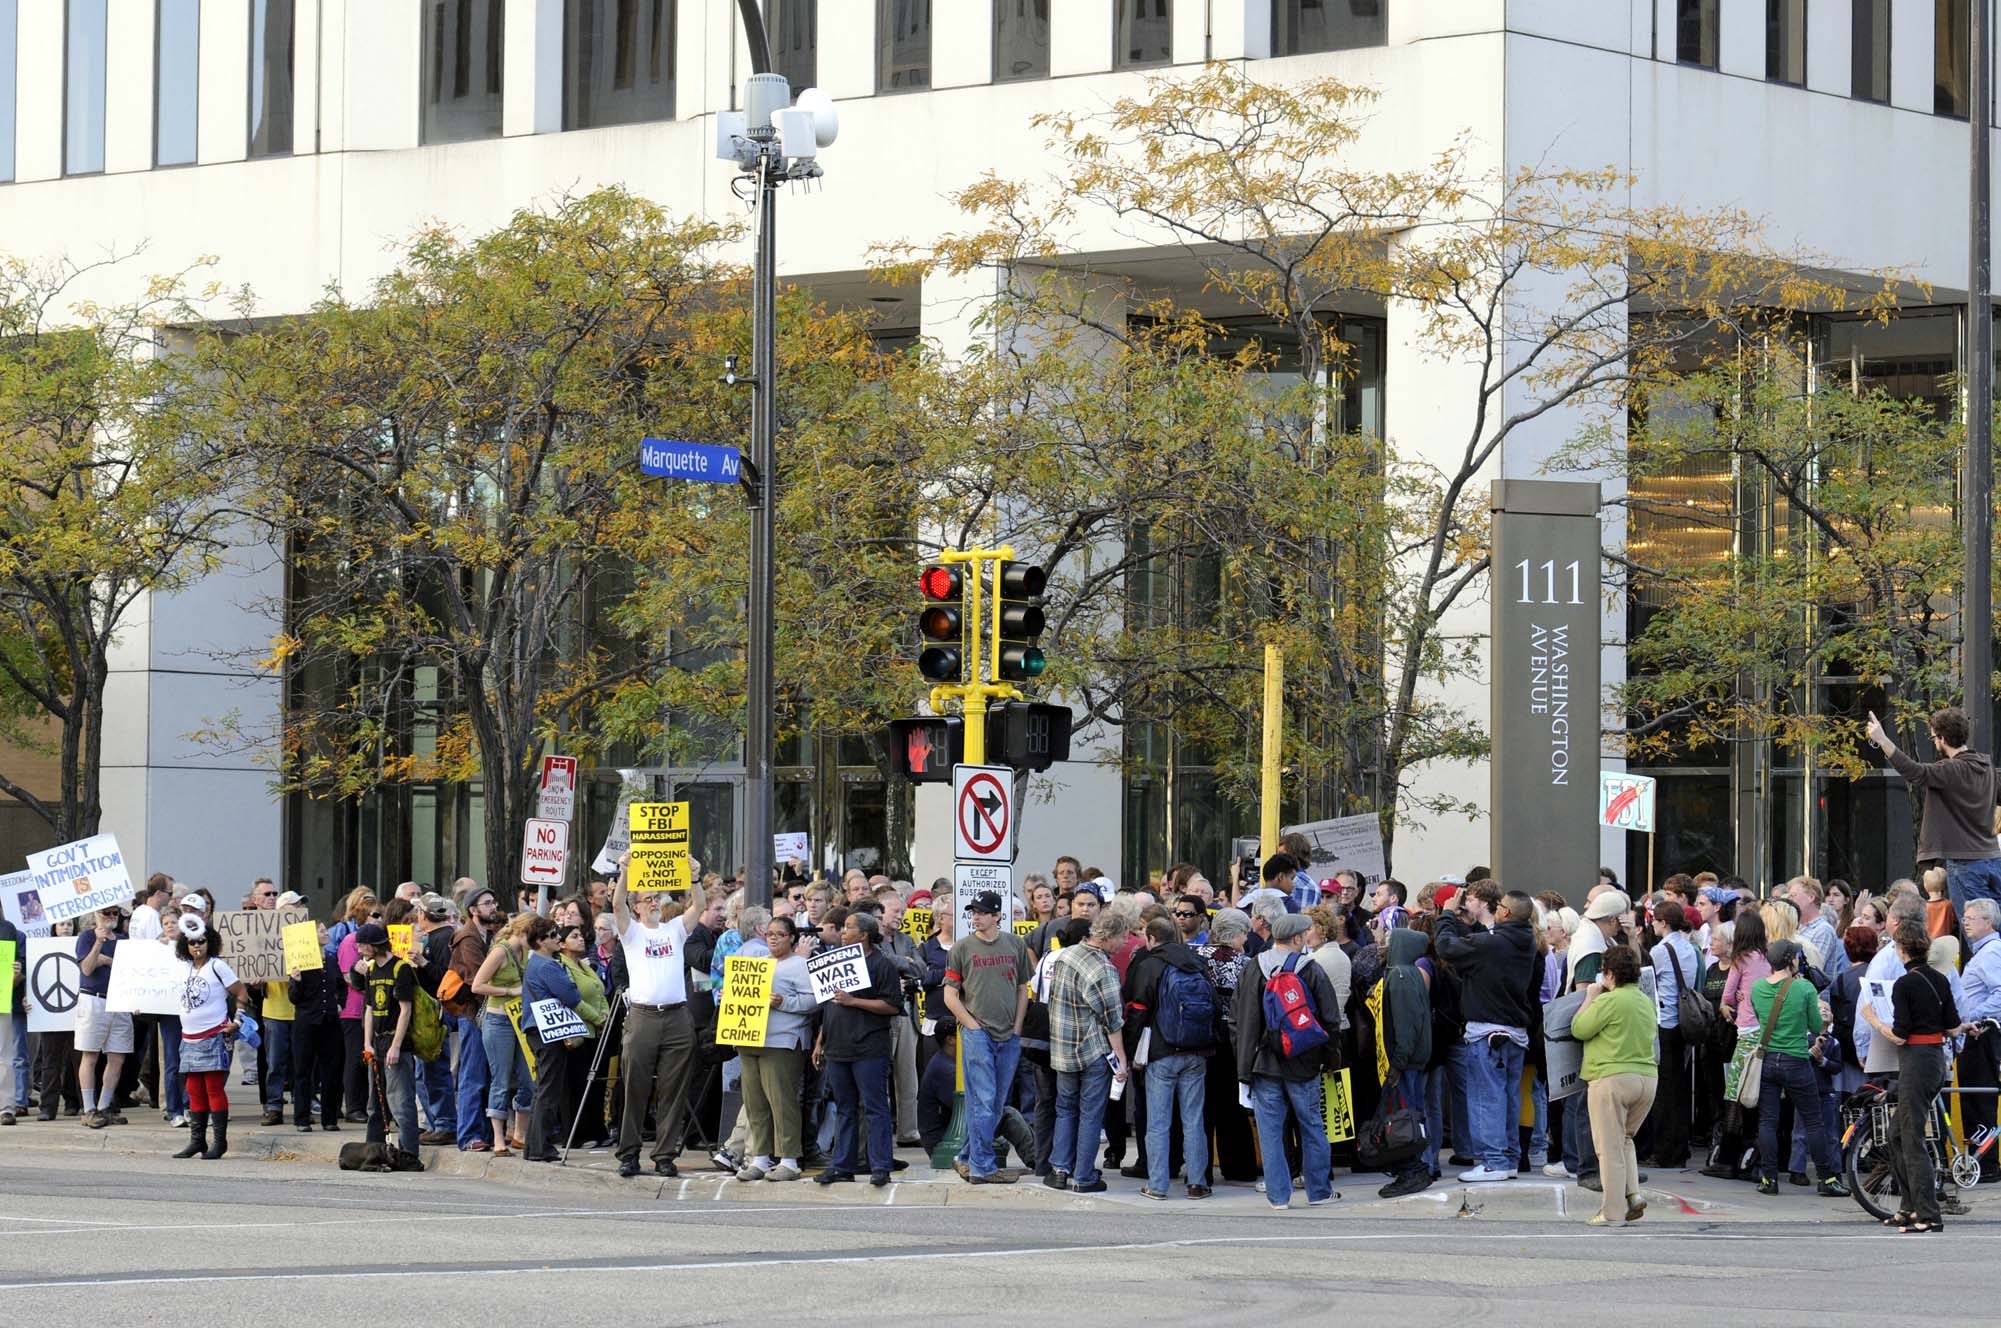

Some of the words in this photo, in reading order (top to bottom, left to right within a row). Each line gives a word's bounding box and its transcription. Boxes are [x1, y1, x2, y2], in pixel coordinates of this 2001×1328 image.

[642, 446, 708, 475] Marquette
[721, 454, 739, 477] Av
[1515, 559, 1585, 605] 111
[1531, 624, 1548, 714] AVENUE
[1552, 624, 1569, 785] WASHINGTON
[547, 784, 566, 795] SNOW
[541, 796, 571, 805] EMERGENCY
[1603, 778, 1649, 829] FBI
[545, 806, 566, 816] ROUTE
[640, 806, 679, 817] STOP
[648, 818, 672, 829] FBI
[536, 828, 556, 844] NO
[632, 831, 686, 841] HARASSMENT
[46, 843, 89, 868] GOV'T
[527, 848, 563, 863] PARKING
[631, 850, 687, 860] OPPOSING
[34, 851, 122, 890] INTIMIDATION
[646, 860, 674, 869] WAR
[652, 869, 677, 878] NOT
[970, 868, 998, 878] EXCEPT
[73, 877, 90, 894] IS
[637, 880, 646, 888] A
[647, 878, 682, 888] CRIME!
[962, 880, 1007, 889] AUTHORIZED
[46, 879, 132, 919] TERRORISM!
[218, 911, 309, 937] ACTIVISM
[230, 939, 246, 954] IS
[731, 960, 768, 973] BEING
[807, 948, 861, 971] SUBPOENA
[731, 973, 766, 986] ANTI-
[816, 962, 857, 986] WAR
[731, 986, 761, 999] WAR
[820, 976, 860, 997] MAKERS
[543, 1008, 578, 1026] WAR
[724, 1004, 735, 1016] IS
[737, 1005, 765, 1017] NOT
[738, 1018, 747, 1029] A
[543, 1024, 587, 1040] SUBPOENA
[721, 1028, 761, 1042] CRIME!
[1560, 1072, 1578, 1089] STOP
[1335, 1080, 1348, 1117] APRIL
[1333, 1107, 1342, 1136] 2011
